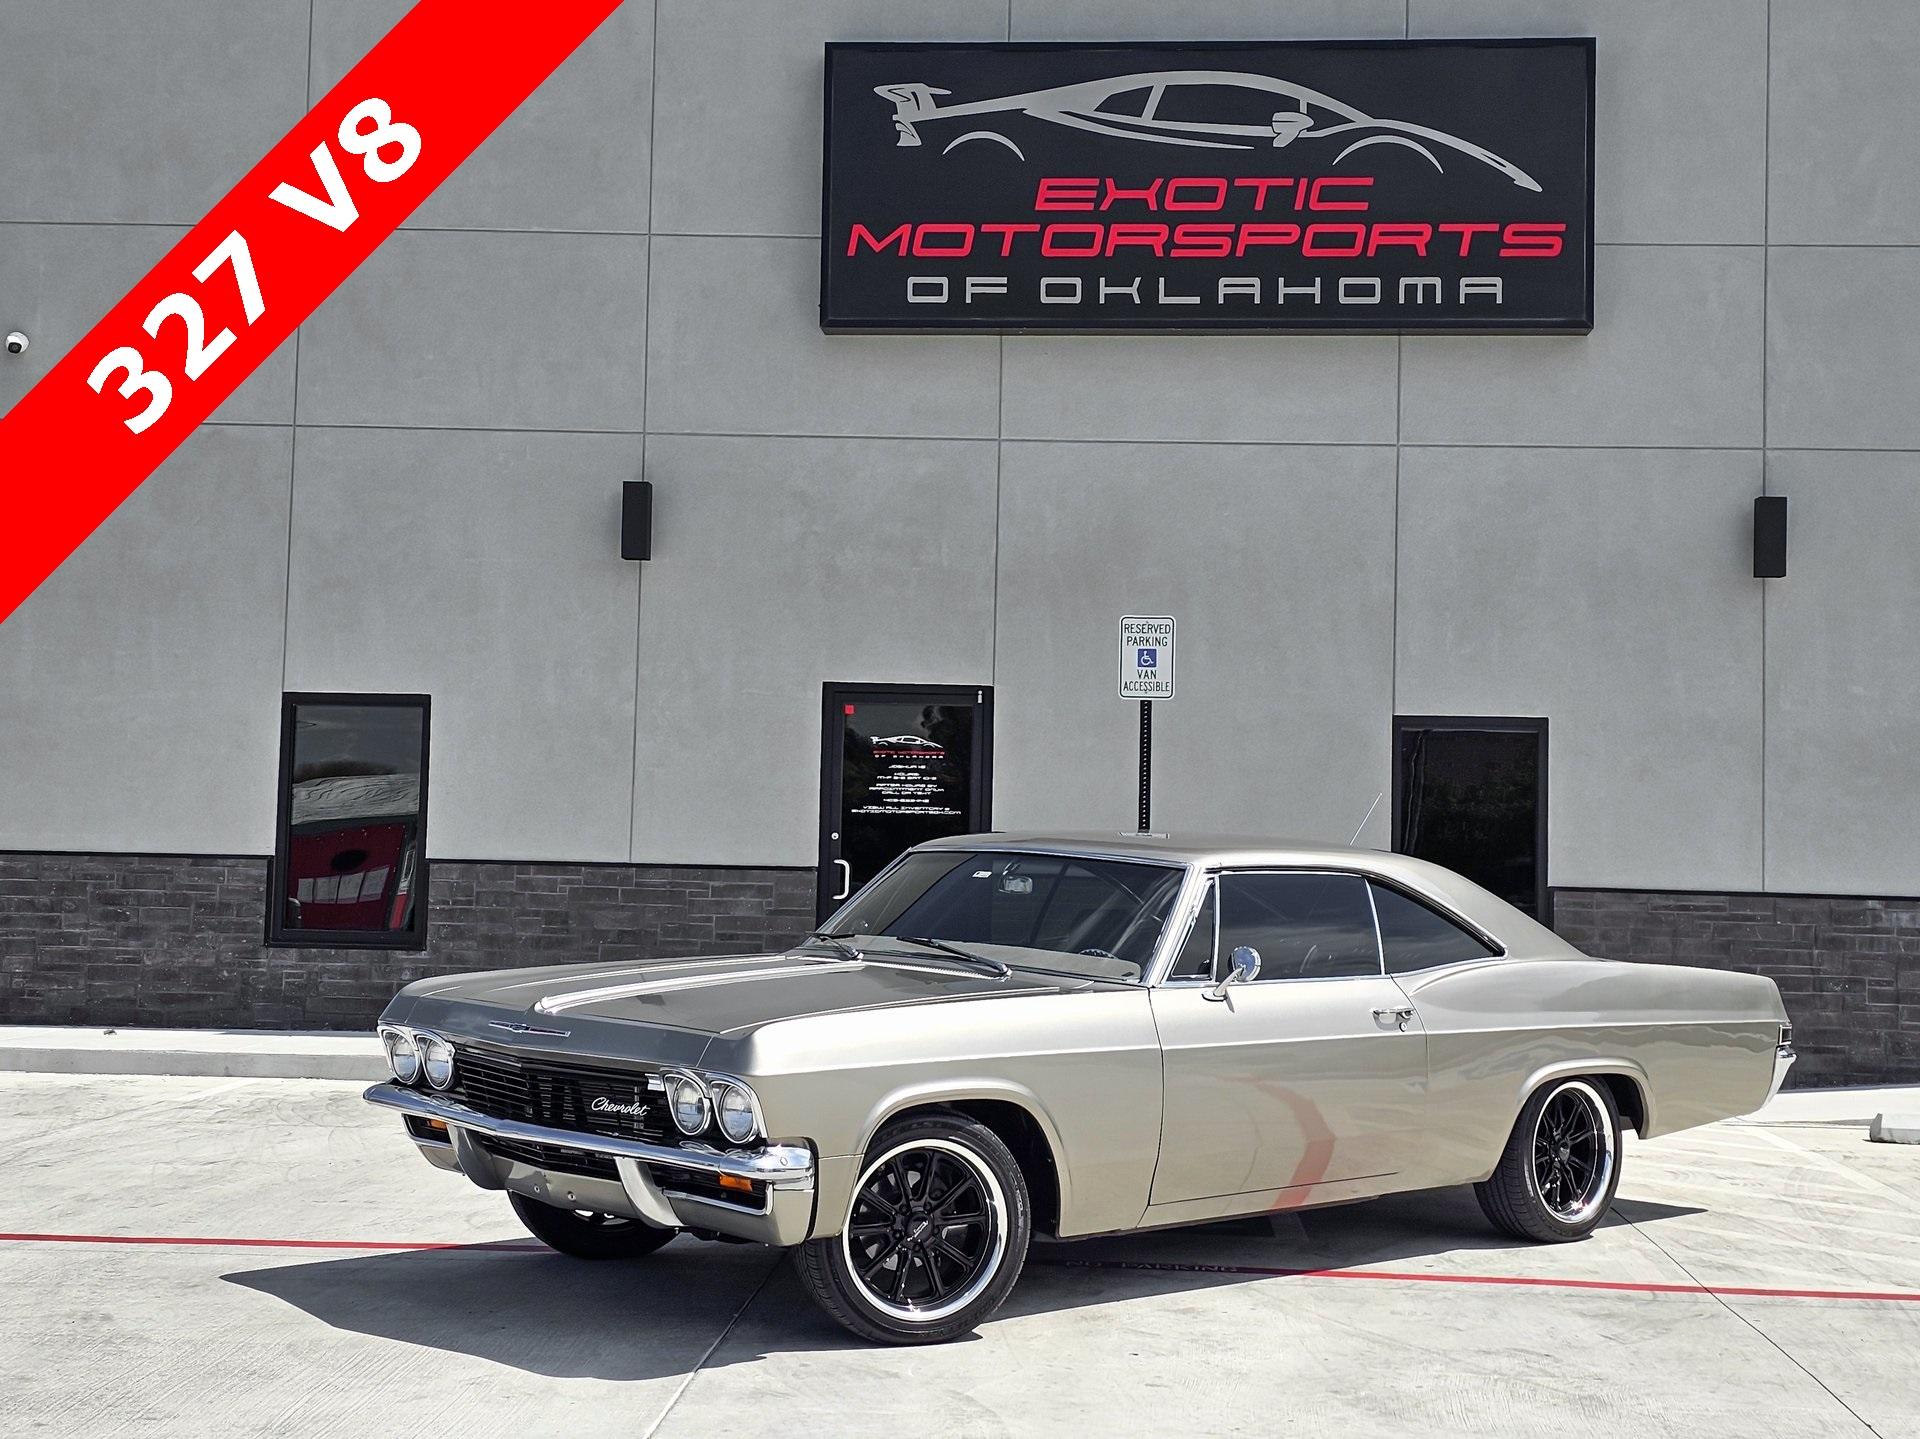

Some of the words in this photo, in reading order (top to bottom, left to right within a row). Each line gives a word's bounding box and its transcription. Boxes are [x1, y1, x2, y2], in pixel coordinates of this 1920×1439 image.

[1035, 177, 1374, 211] EXOTIC
[847, 223, 1566, 257] MOTORSPORTS
[907, 277, 1008, 304] OF
[1040, 277, 1503, 304] OKLAHOMA
[1124, 624, 1171, 634] RESERVED
[1127, 636, 1168, 646] PARKING
[1137, 669, 1157, 679] VAN
[1123, 681, 1170, 692] ACCESSIBLE
[591, 1096, 651, 1116] Chevrolet
